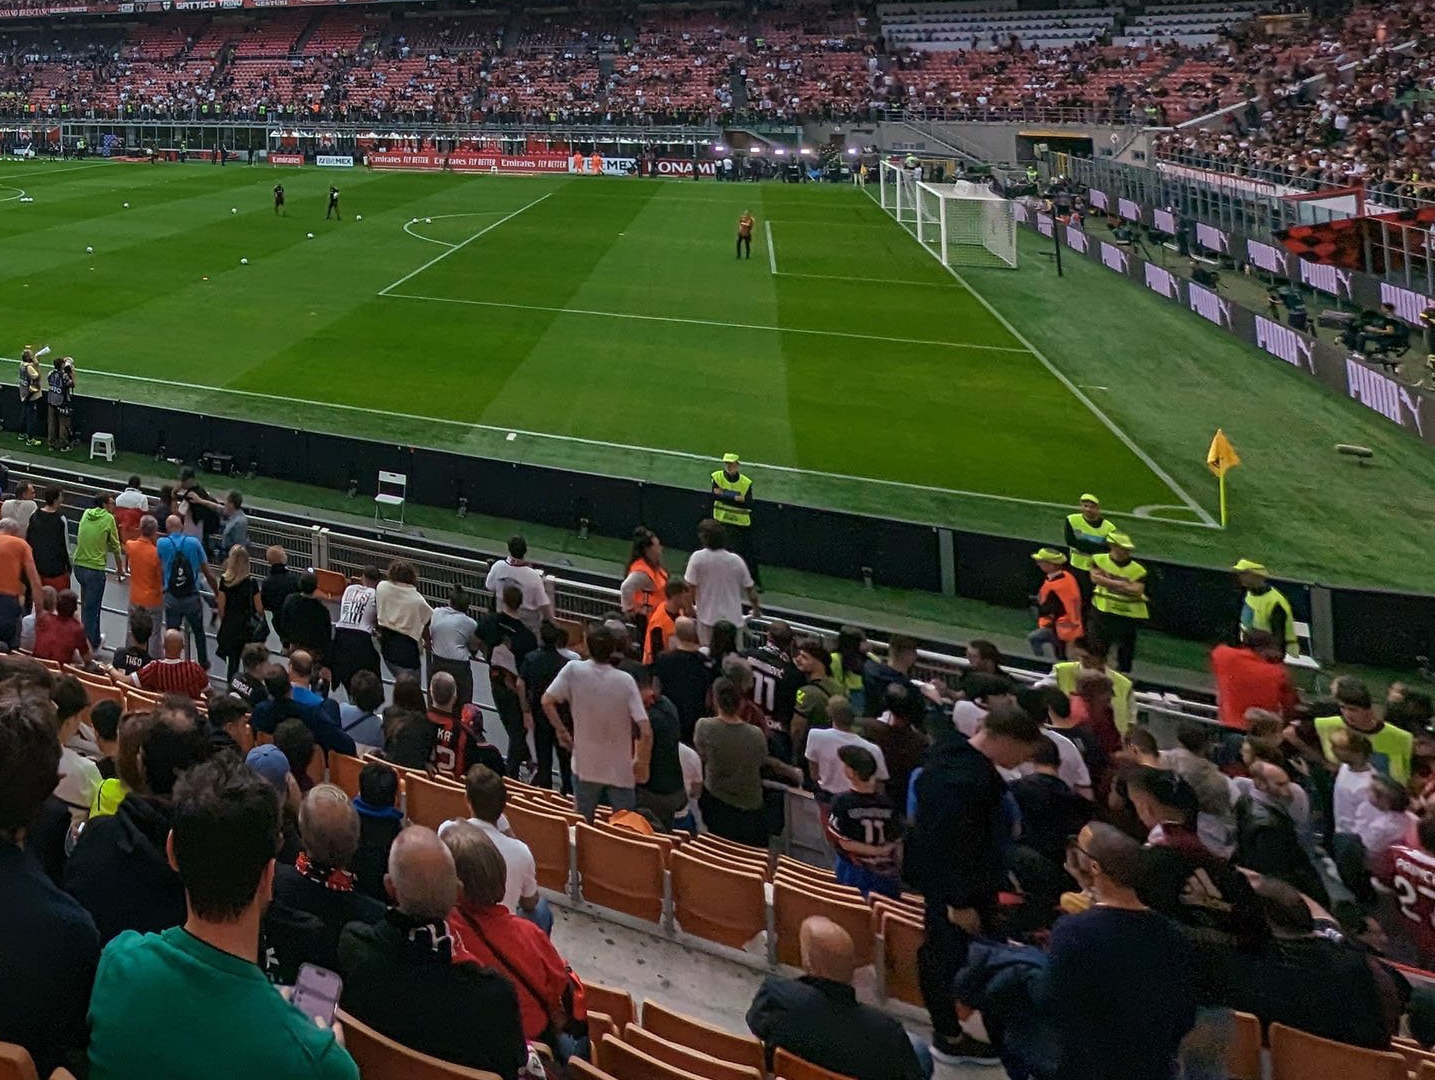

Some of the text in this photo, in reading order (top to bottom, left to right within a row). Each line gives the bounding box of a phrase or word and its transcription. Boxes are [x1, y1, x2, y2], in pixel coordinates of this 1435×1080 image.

[176, 0, 216, 10] GATTICO
[272, 156, 301, 164] Emirates
[501, 159, 536, 168] Emirates
[752, 670, 776, 712] 11
